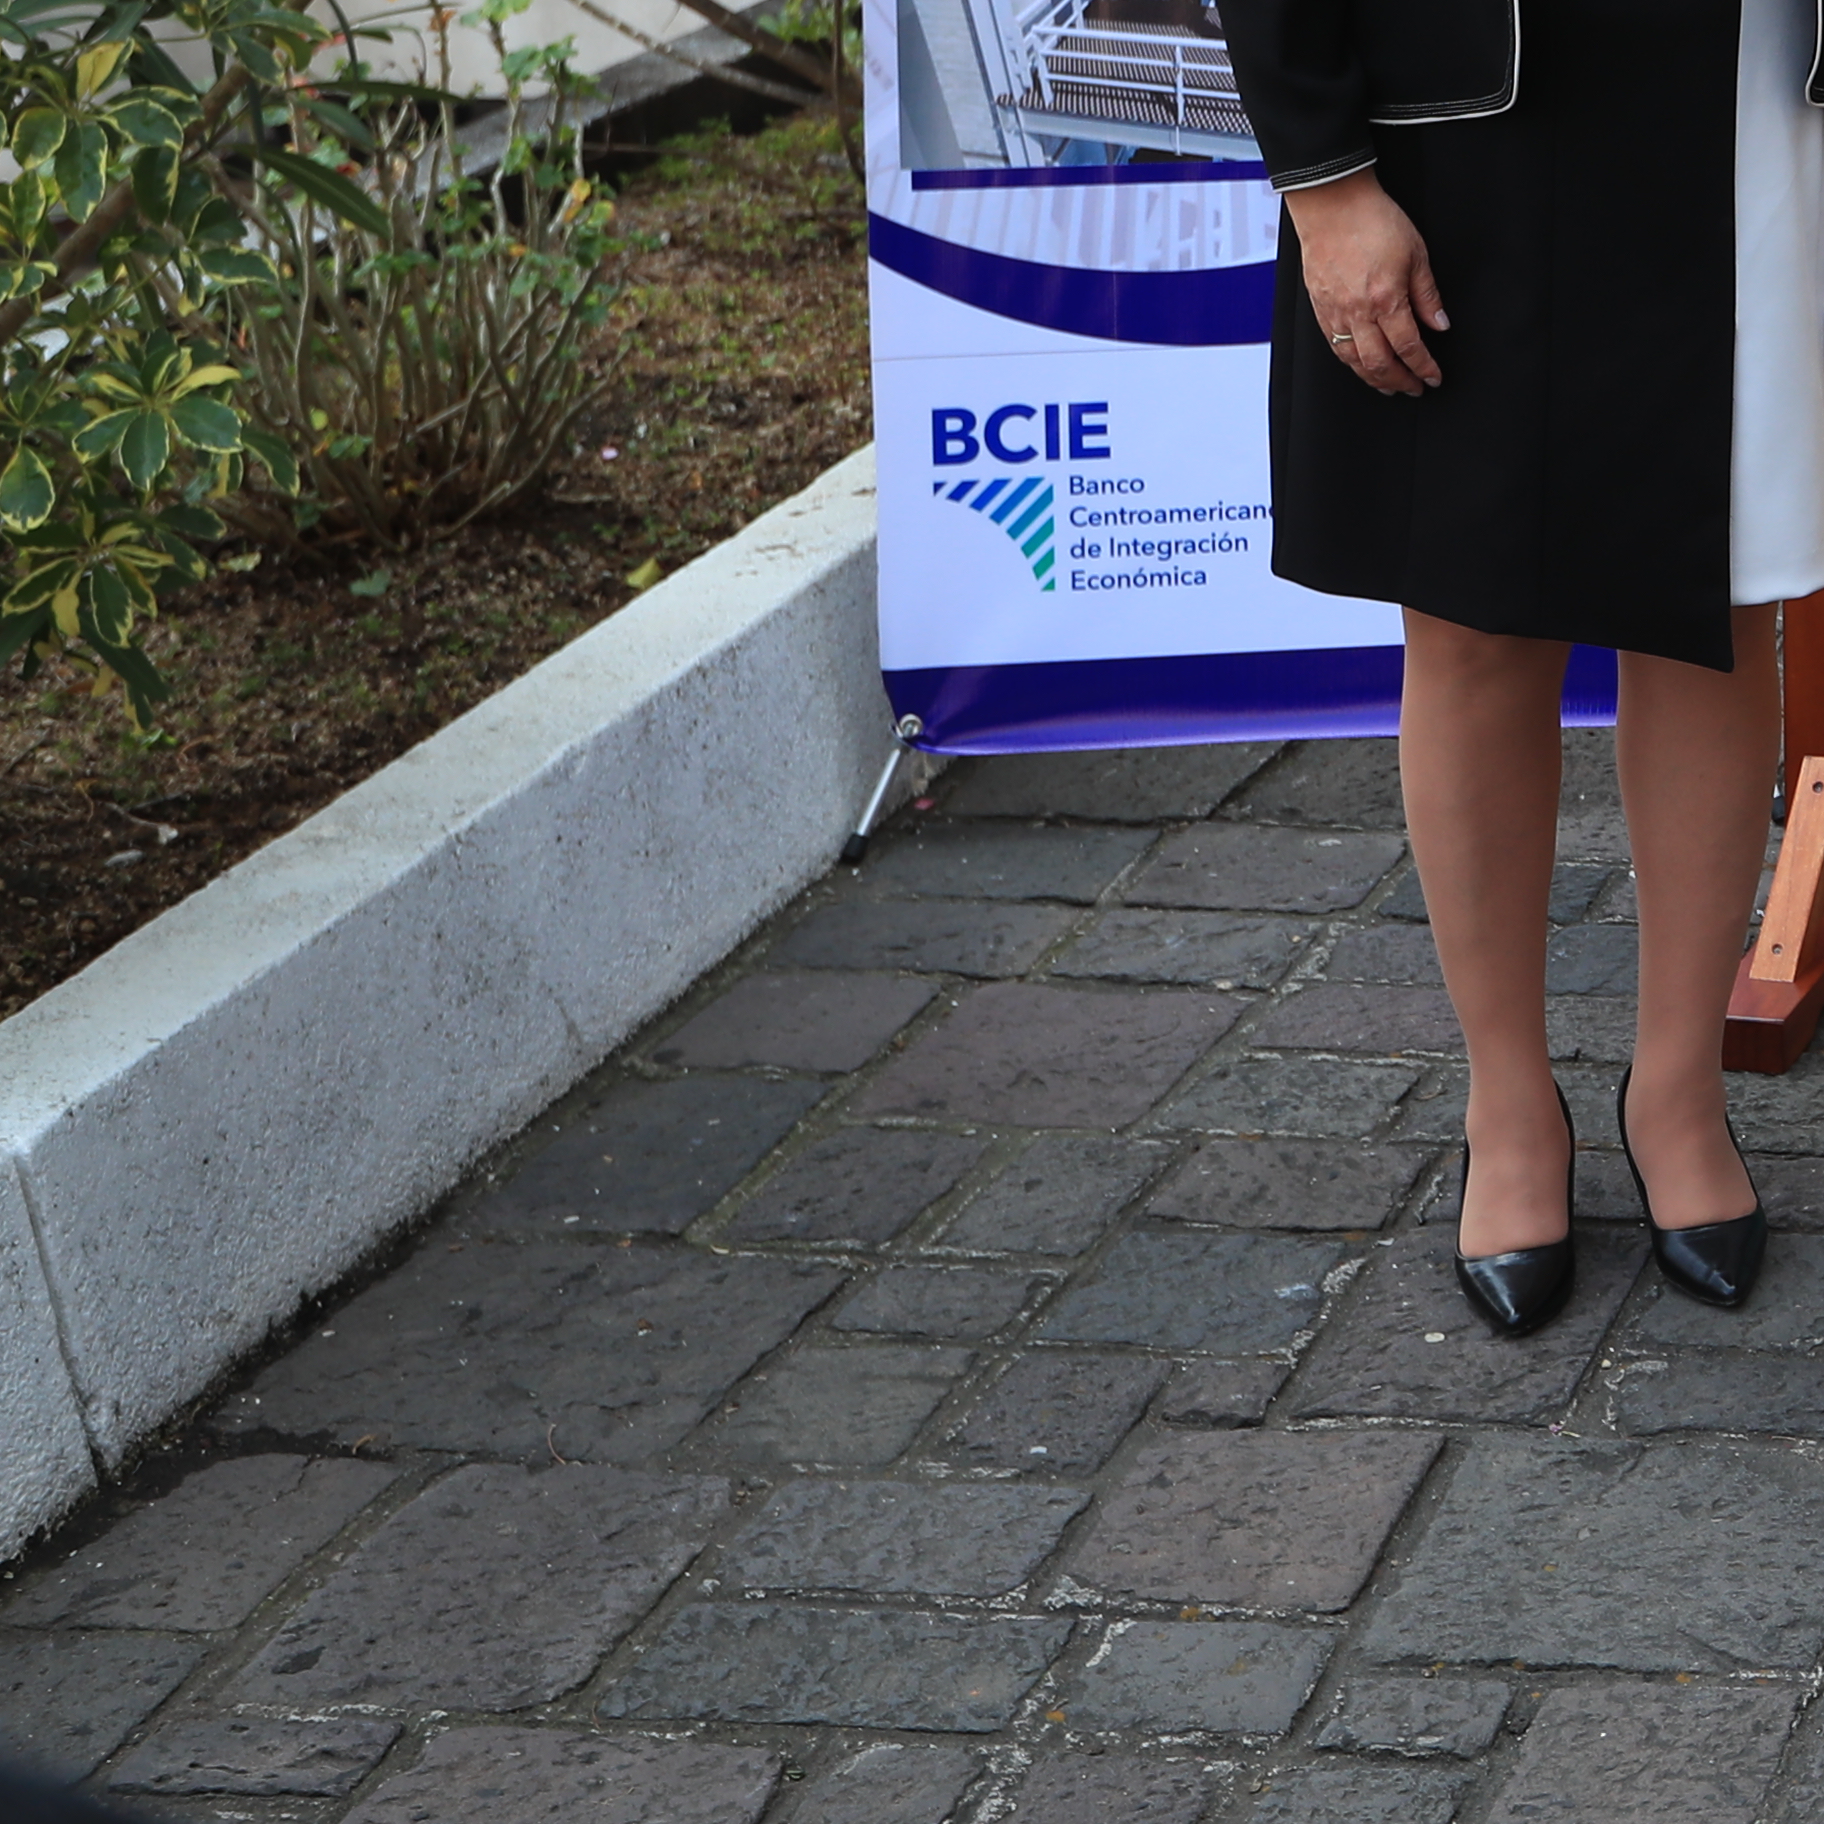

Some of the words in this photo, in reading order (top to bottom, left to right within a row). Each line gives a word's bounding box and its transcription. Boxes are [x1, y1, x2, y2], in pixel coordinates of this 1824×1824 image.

[932, 402, 1111, 466] BCIE
[1069, 475, 1145, 496] Banco
[1069, 501, 1274, 528] Centroamerican
[1070, 537, 1101, 559] de
[1110, 534, 1249, 562] Integración
[1070, 567, 1207, 592] Económica
